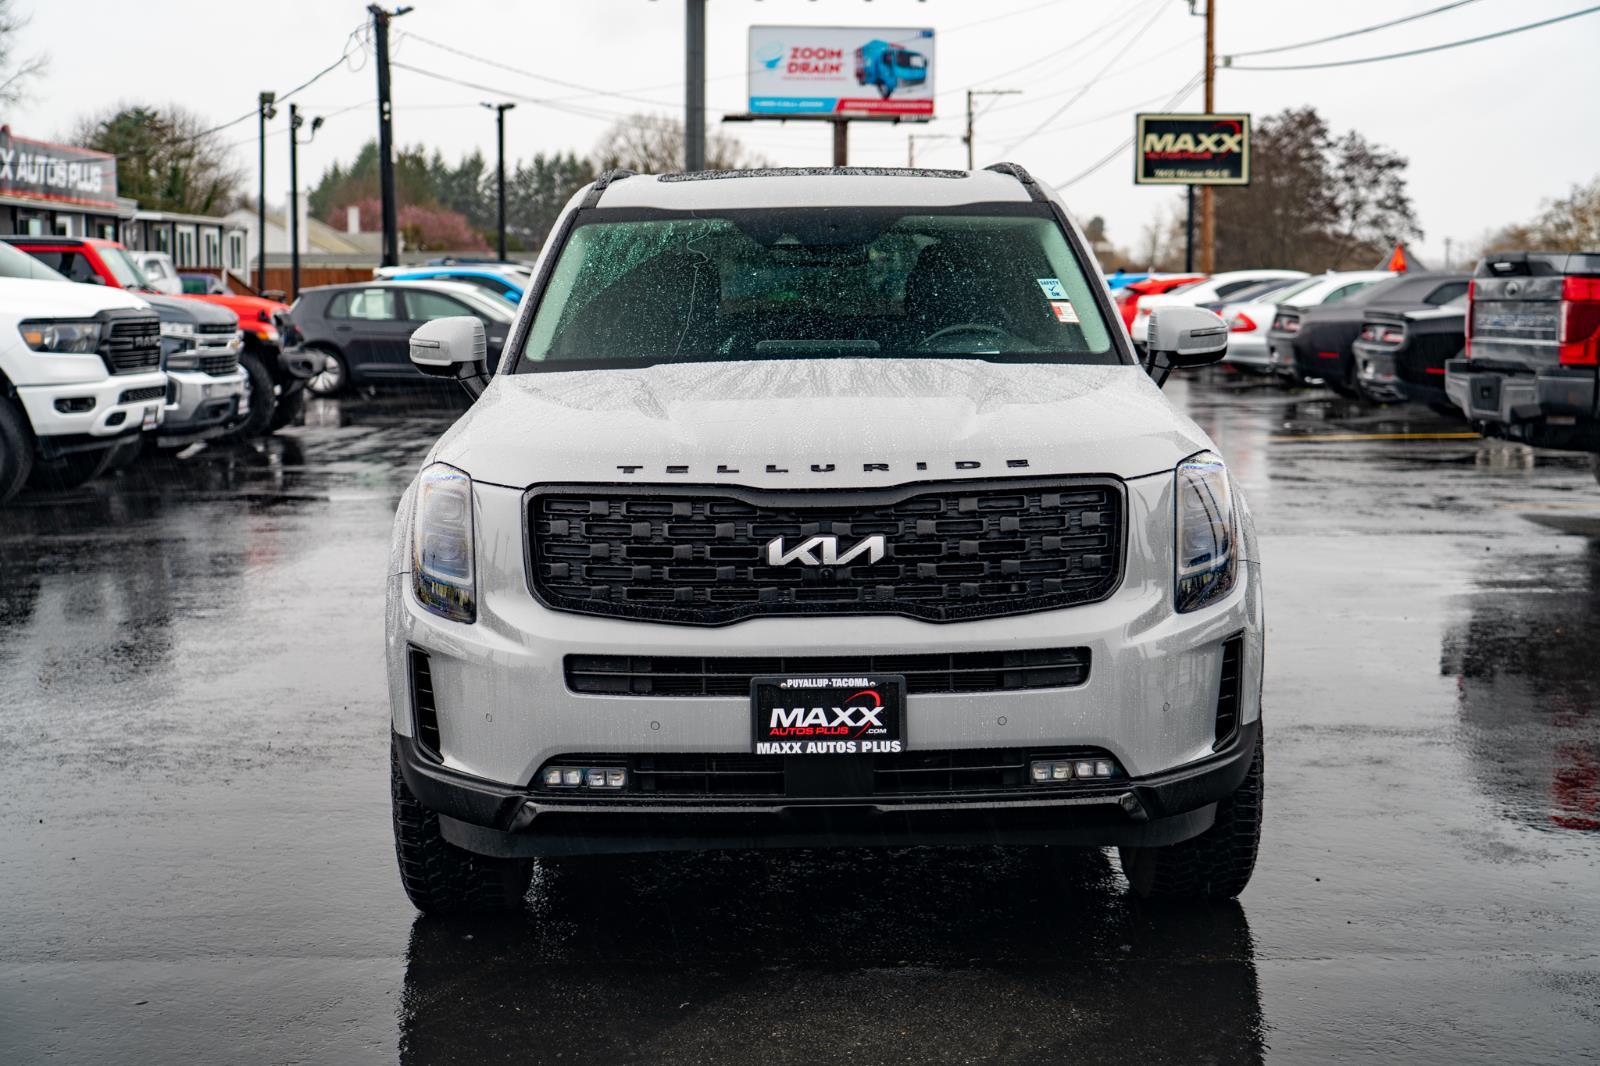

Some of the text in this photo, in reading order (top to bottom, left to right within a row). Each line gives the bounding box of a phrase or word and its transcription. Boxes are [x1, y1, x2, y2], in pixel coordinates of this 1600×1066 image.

[790, 47, 843, 60] ZOOM
[787, 62, 841, 74] DRAIN
[1144, 133, 1242, 153] MAXX
[16, 152, 67, 188] AUTOS
[68, 160, 102, 193] PLUS
[617, 458, 1031, 474] TELLURIDE
[769, 706, 885, 728] MAXX
[769, 727, 815, 736] AUTOS
[816, 727, 849, 735] PLUS
[756, 740, 902, 755] MAXX AUTOS PLUS
